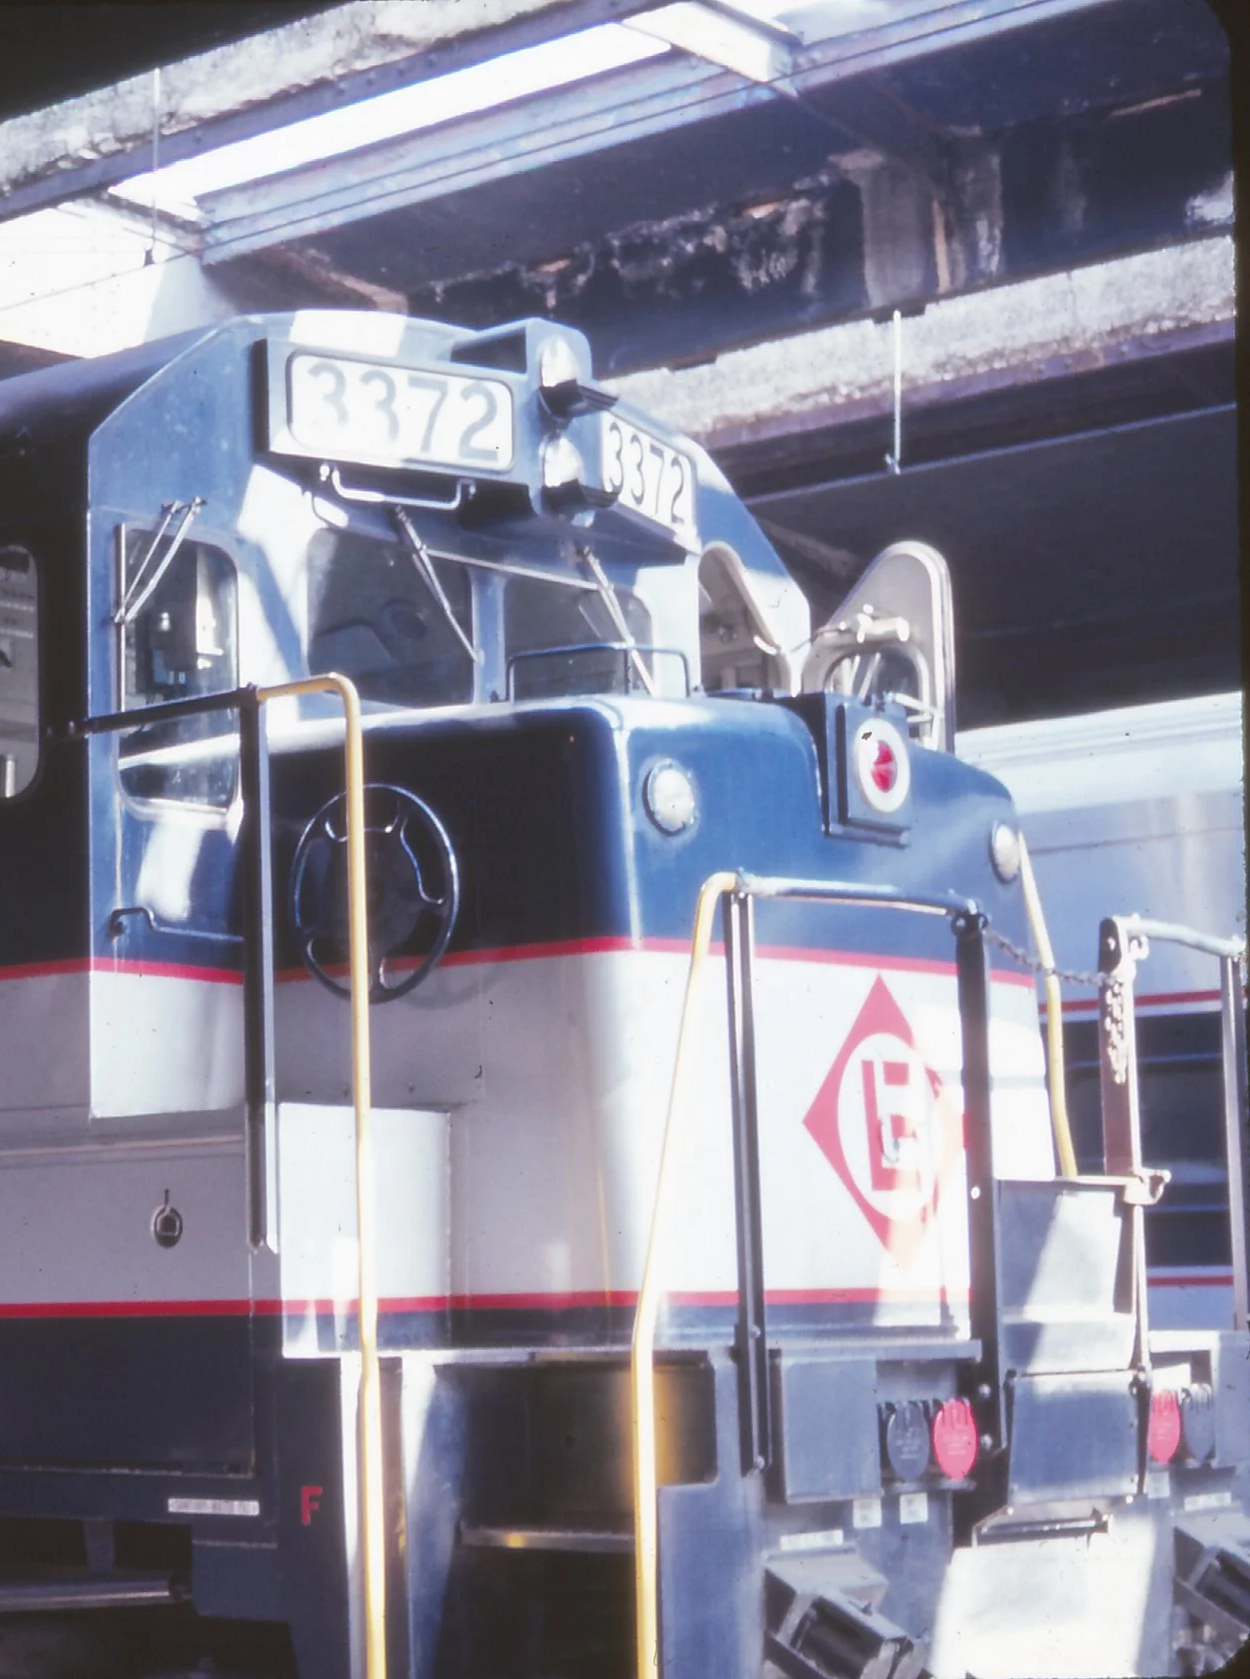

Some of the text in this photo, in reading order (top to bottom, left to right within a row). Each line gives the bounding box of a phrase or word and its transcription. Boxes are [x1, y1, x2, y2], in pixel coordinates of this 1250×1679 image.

[305, 362, 500, 463] 3372
[608, 420, 686, 526] 3372
[301, 1485, 324, 1526] F
